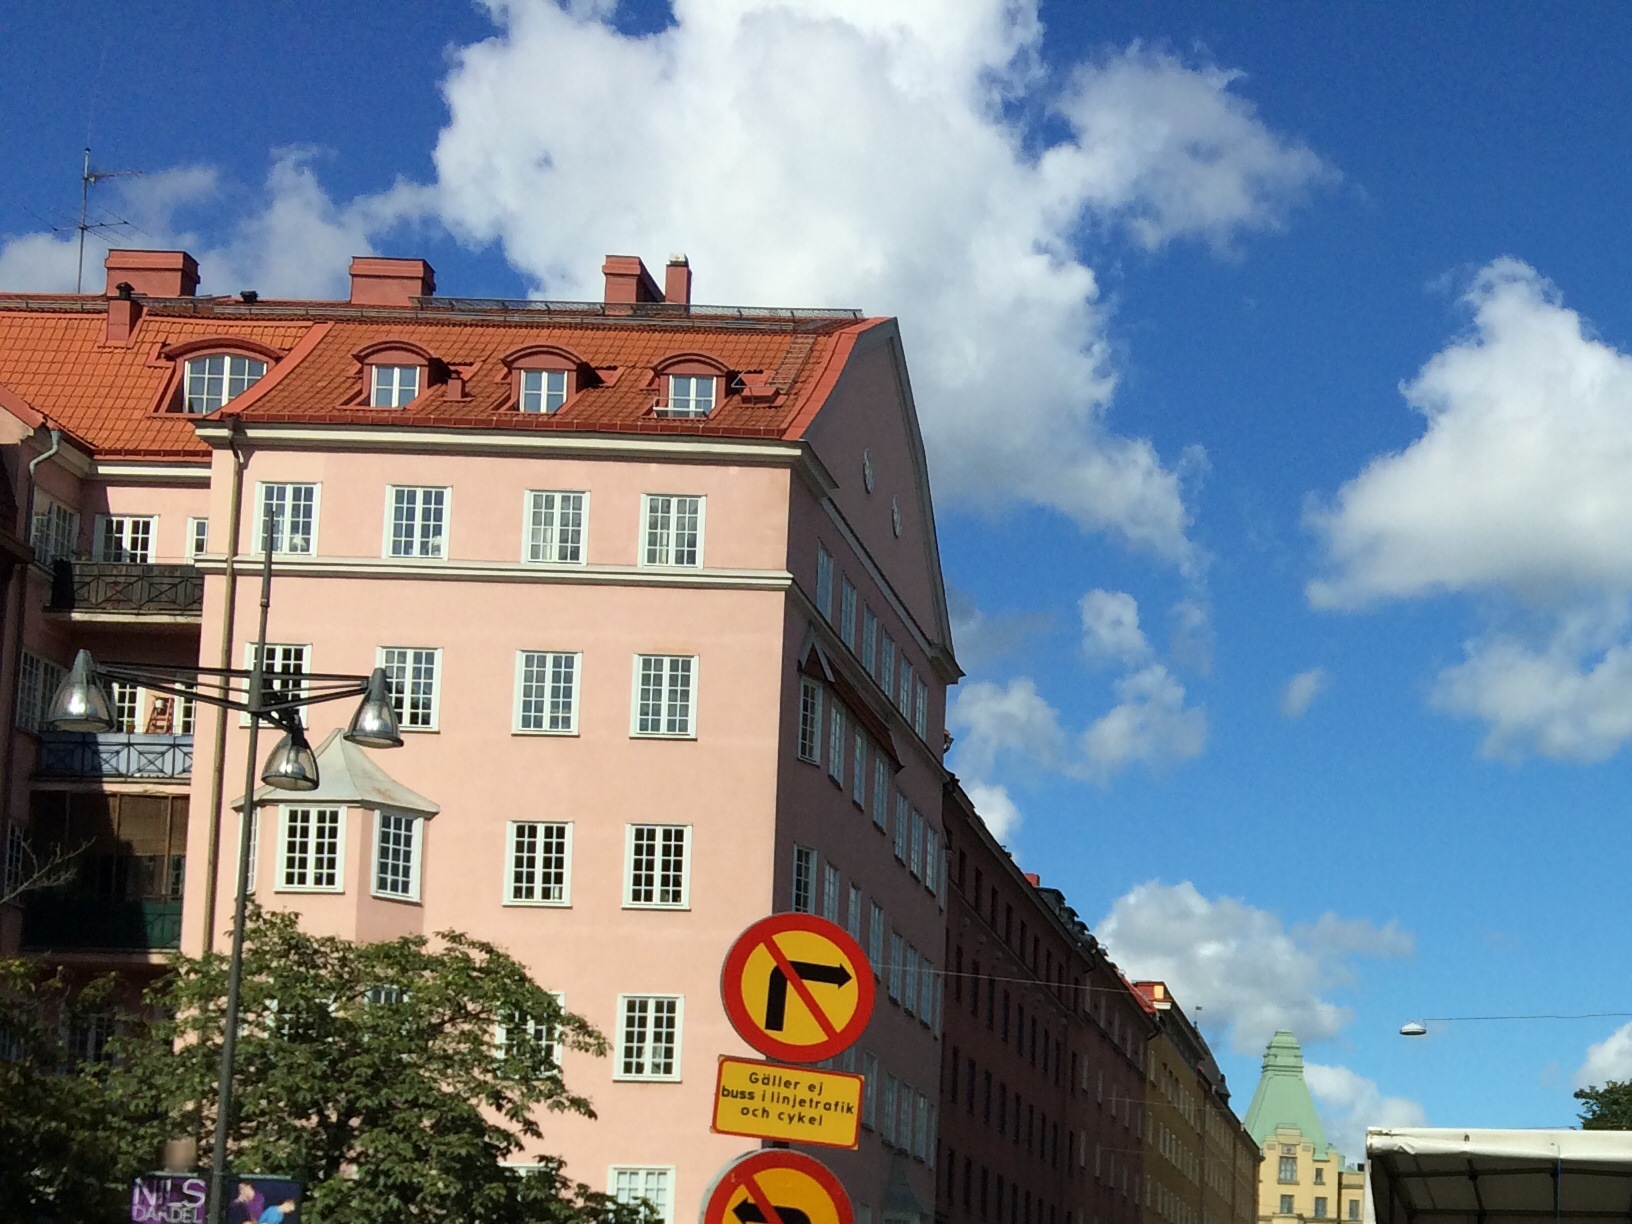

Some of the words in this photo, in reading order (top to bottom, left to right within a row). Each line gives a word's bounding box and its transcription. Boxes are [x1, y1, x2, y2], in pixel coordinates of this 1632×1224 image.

[749, 1072, 800, 1090] Gäller
[808, 1082, 823, 1095] ej
[721, 1085, 755, 1100] buss
[770, 1091, 854, 1114] linjetrafik
[741, 1106, 769, 1119] och
[778, 1111, 822, 1126] cykel
